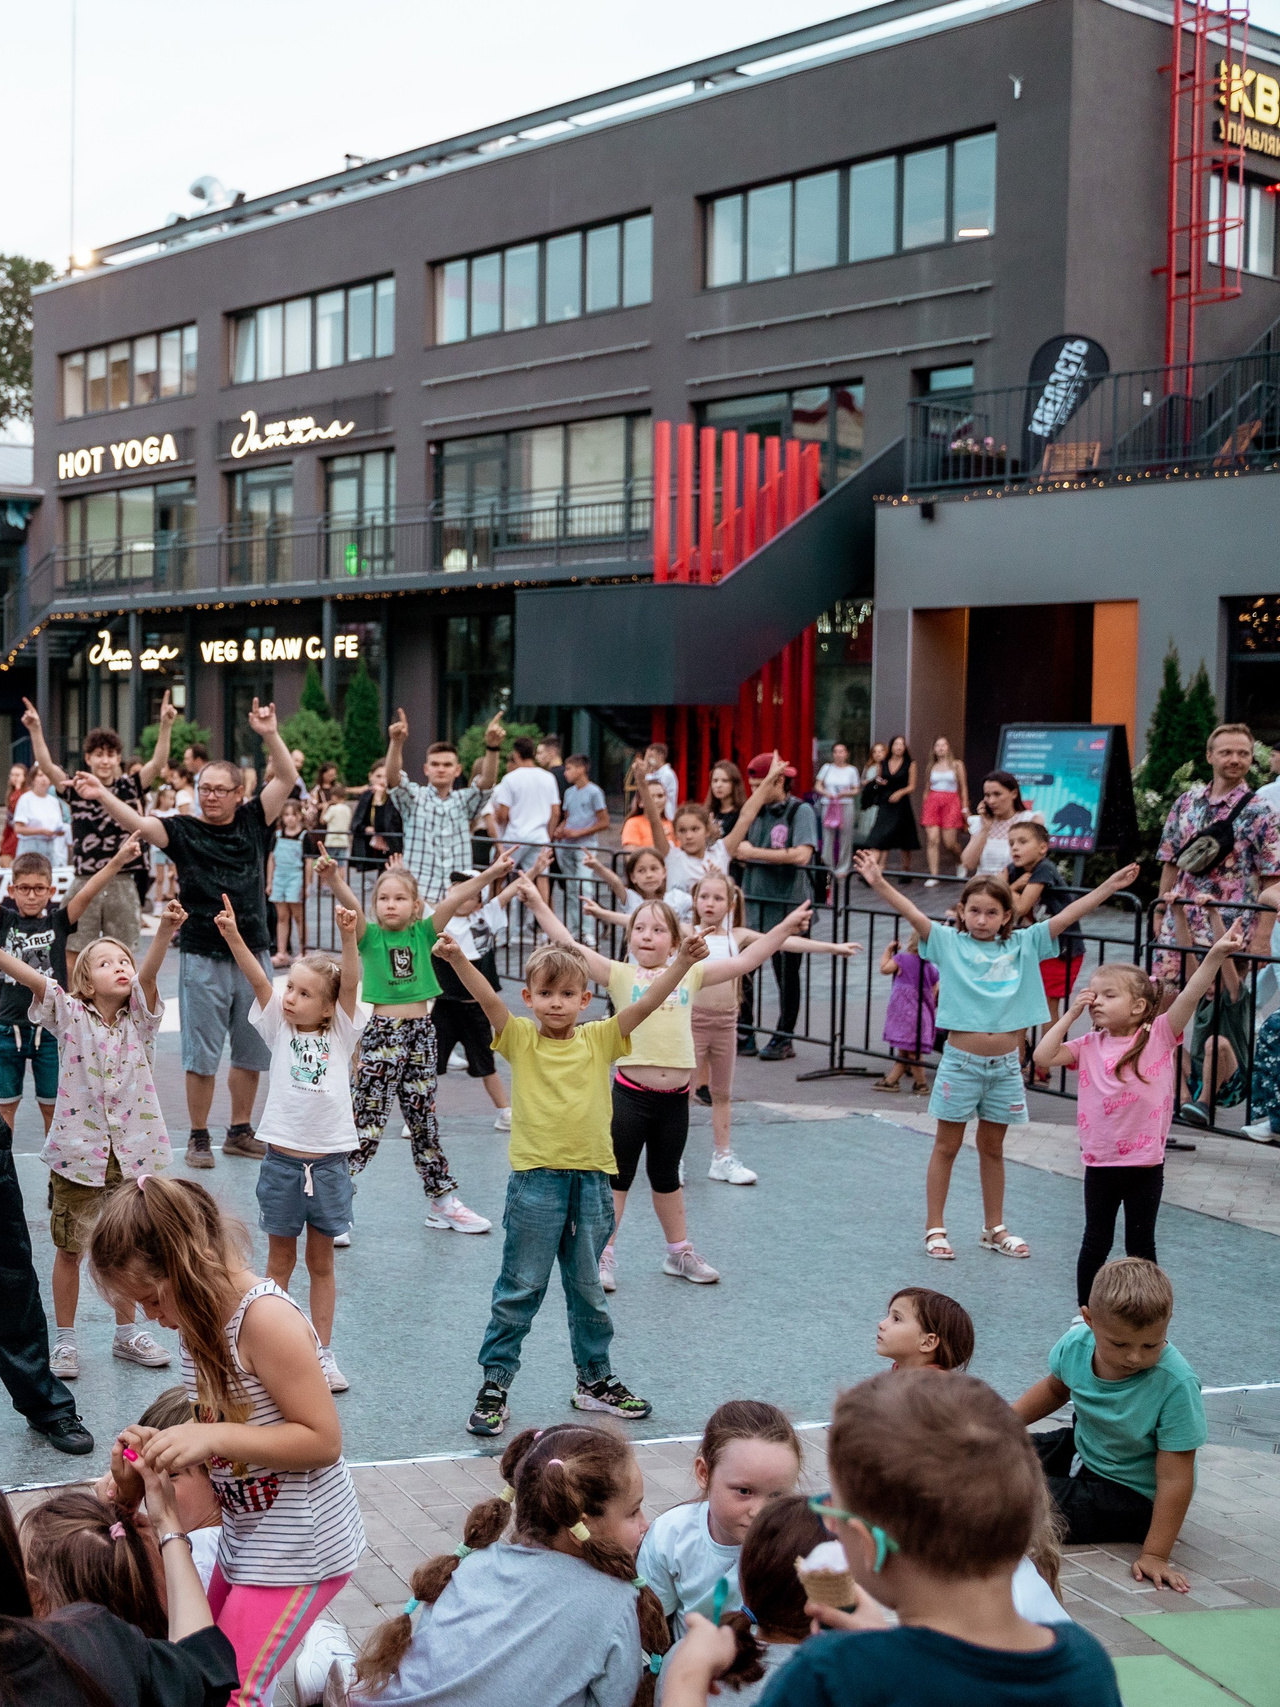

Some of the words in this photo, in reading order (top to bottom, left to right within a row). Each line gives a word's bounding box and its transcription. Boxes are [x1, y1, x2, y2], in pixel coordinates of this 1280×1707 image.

[1218, 117, 1280, 157] УПРАВЛЯ
[58, 446, 105, 480] HOT
[109, 433, 178, 470] YOGA
[200, 640, 238, 663] VEG
[242, 638, 257, 662] &
[260, 637, 303, 661] RAW
[305, 634, 359, 660] CFE
[1103, 1091, 1140, 1116] Barbie
